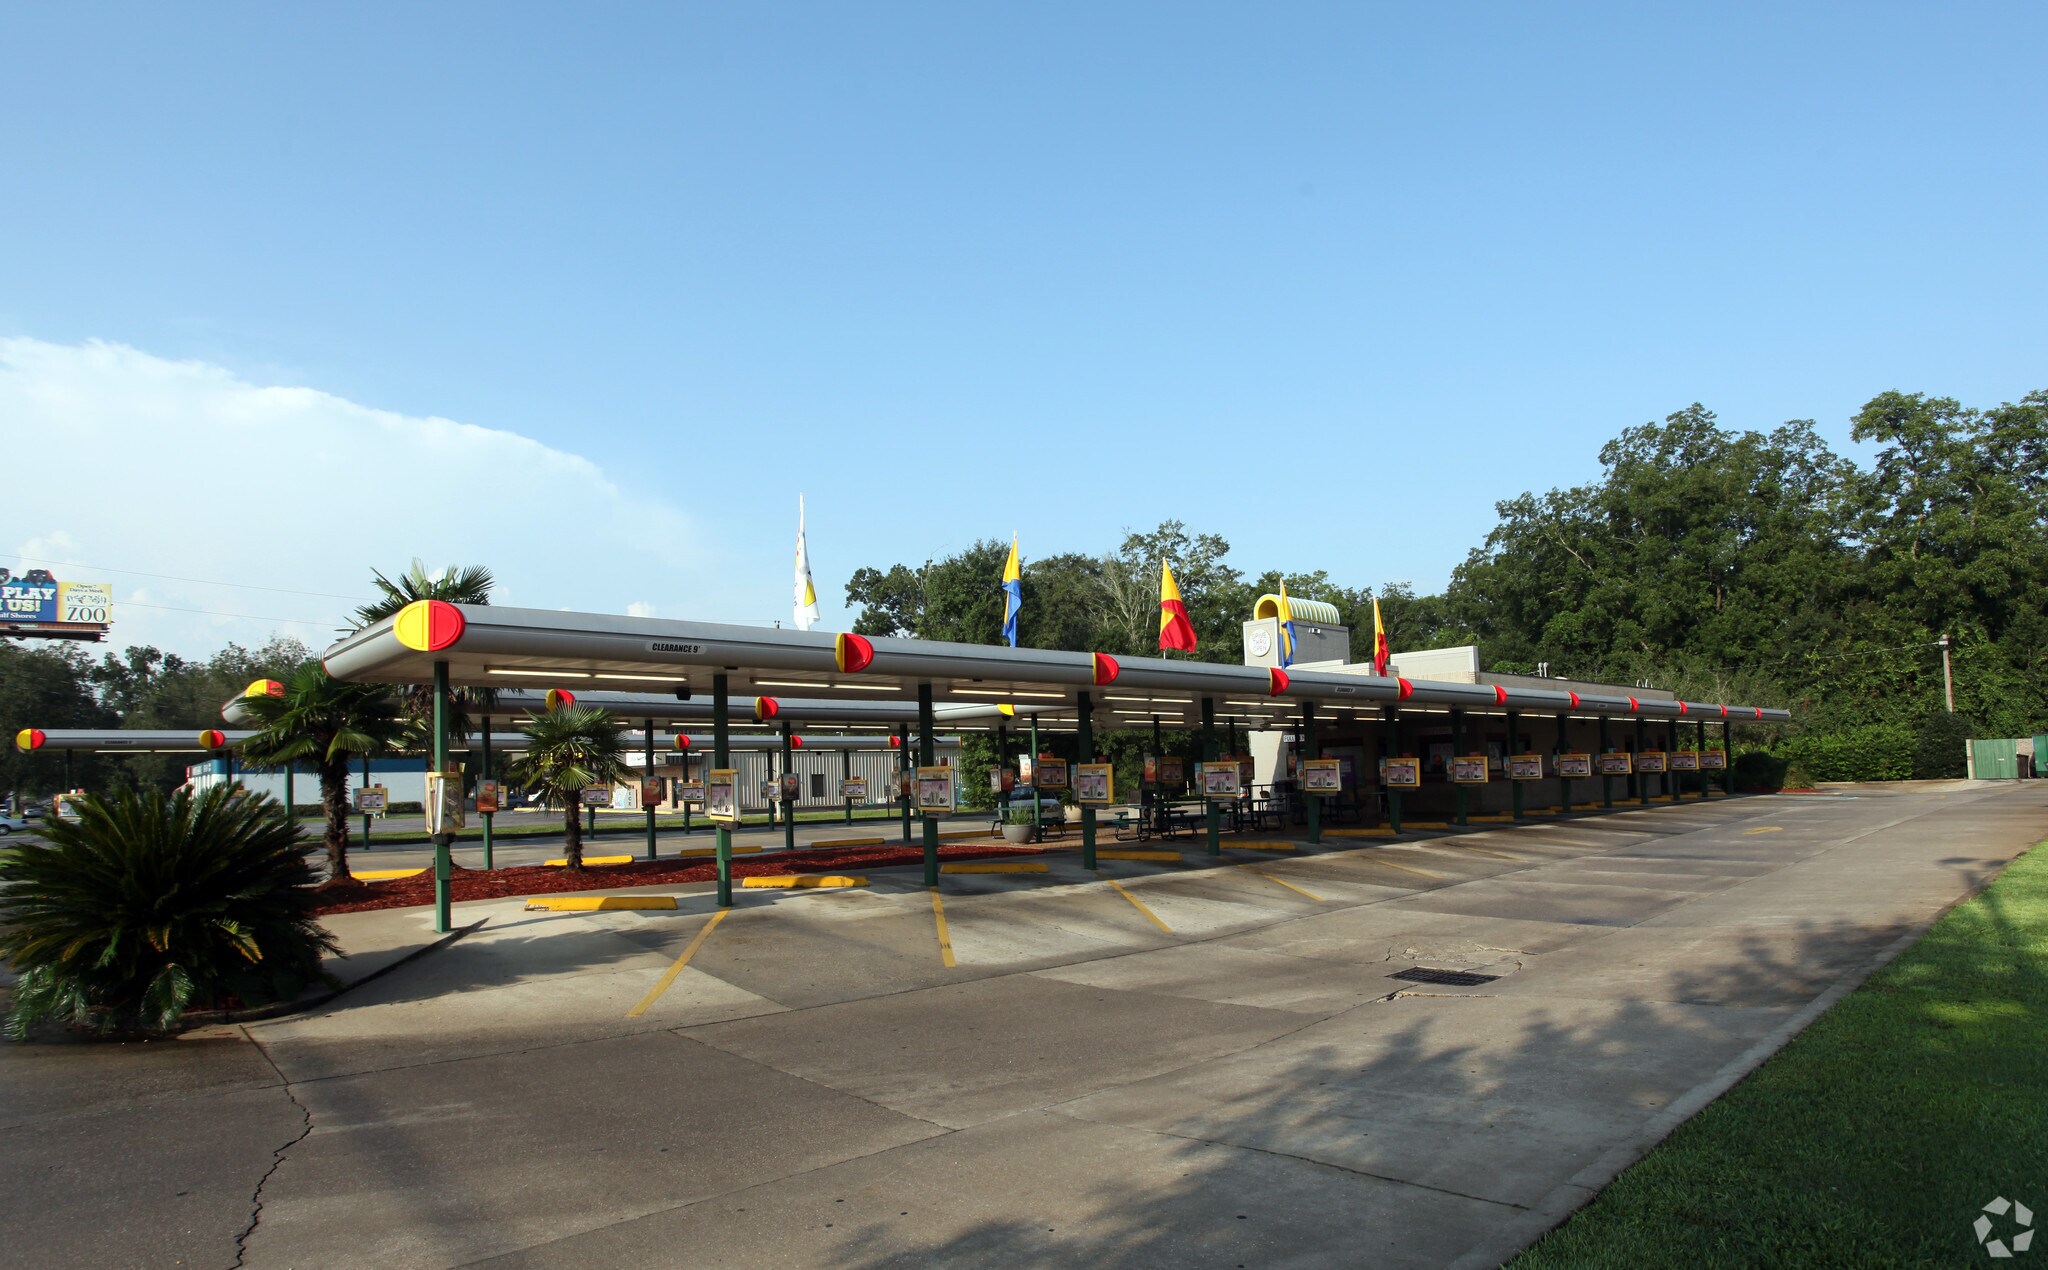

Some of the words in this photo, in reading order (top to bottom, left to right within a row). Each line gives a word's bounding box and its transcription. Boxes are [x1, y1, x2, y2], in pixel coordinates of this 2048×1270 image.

[2, 586, 56, 600] PLAY
[7, 599, 41, 612] US!
[67, 607, 106, 622] ZOO
[652, 643, 692, 653] CLEARANCE
